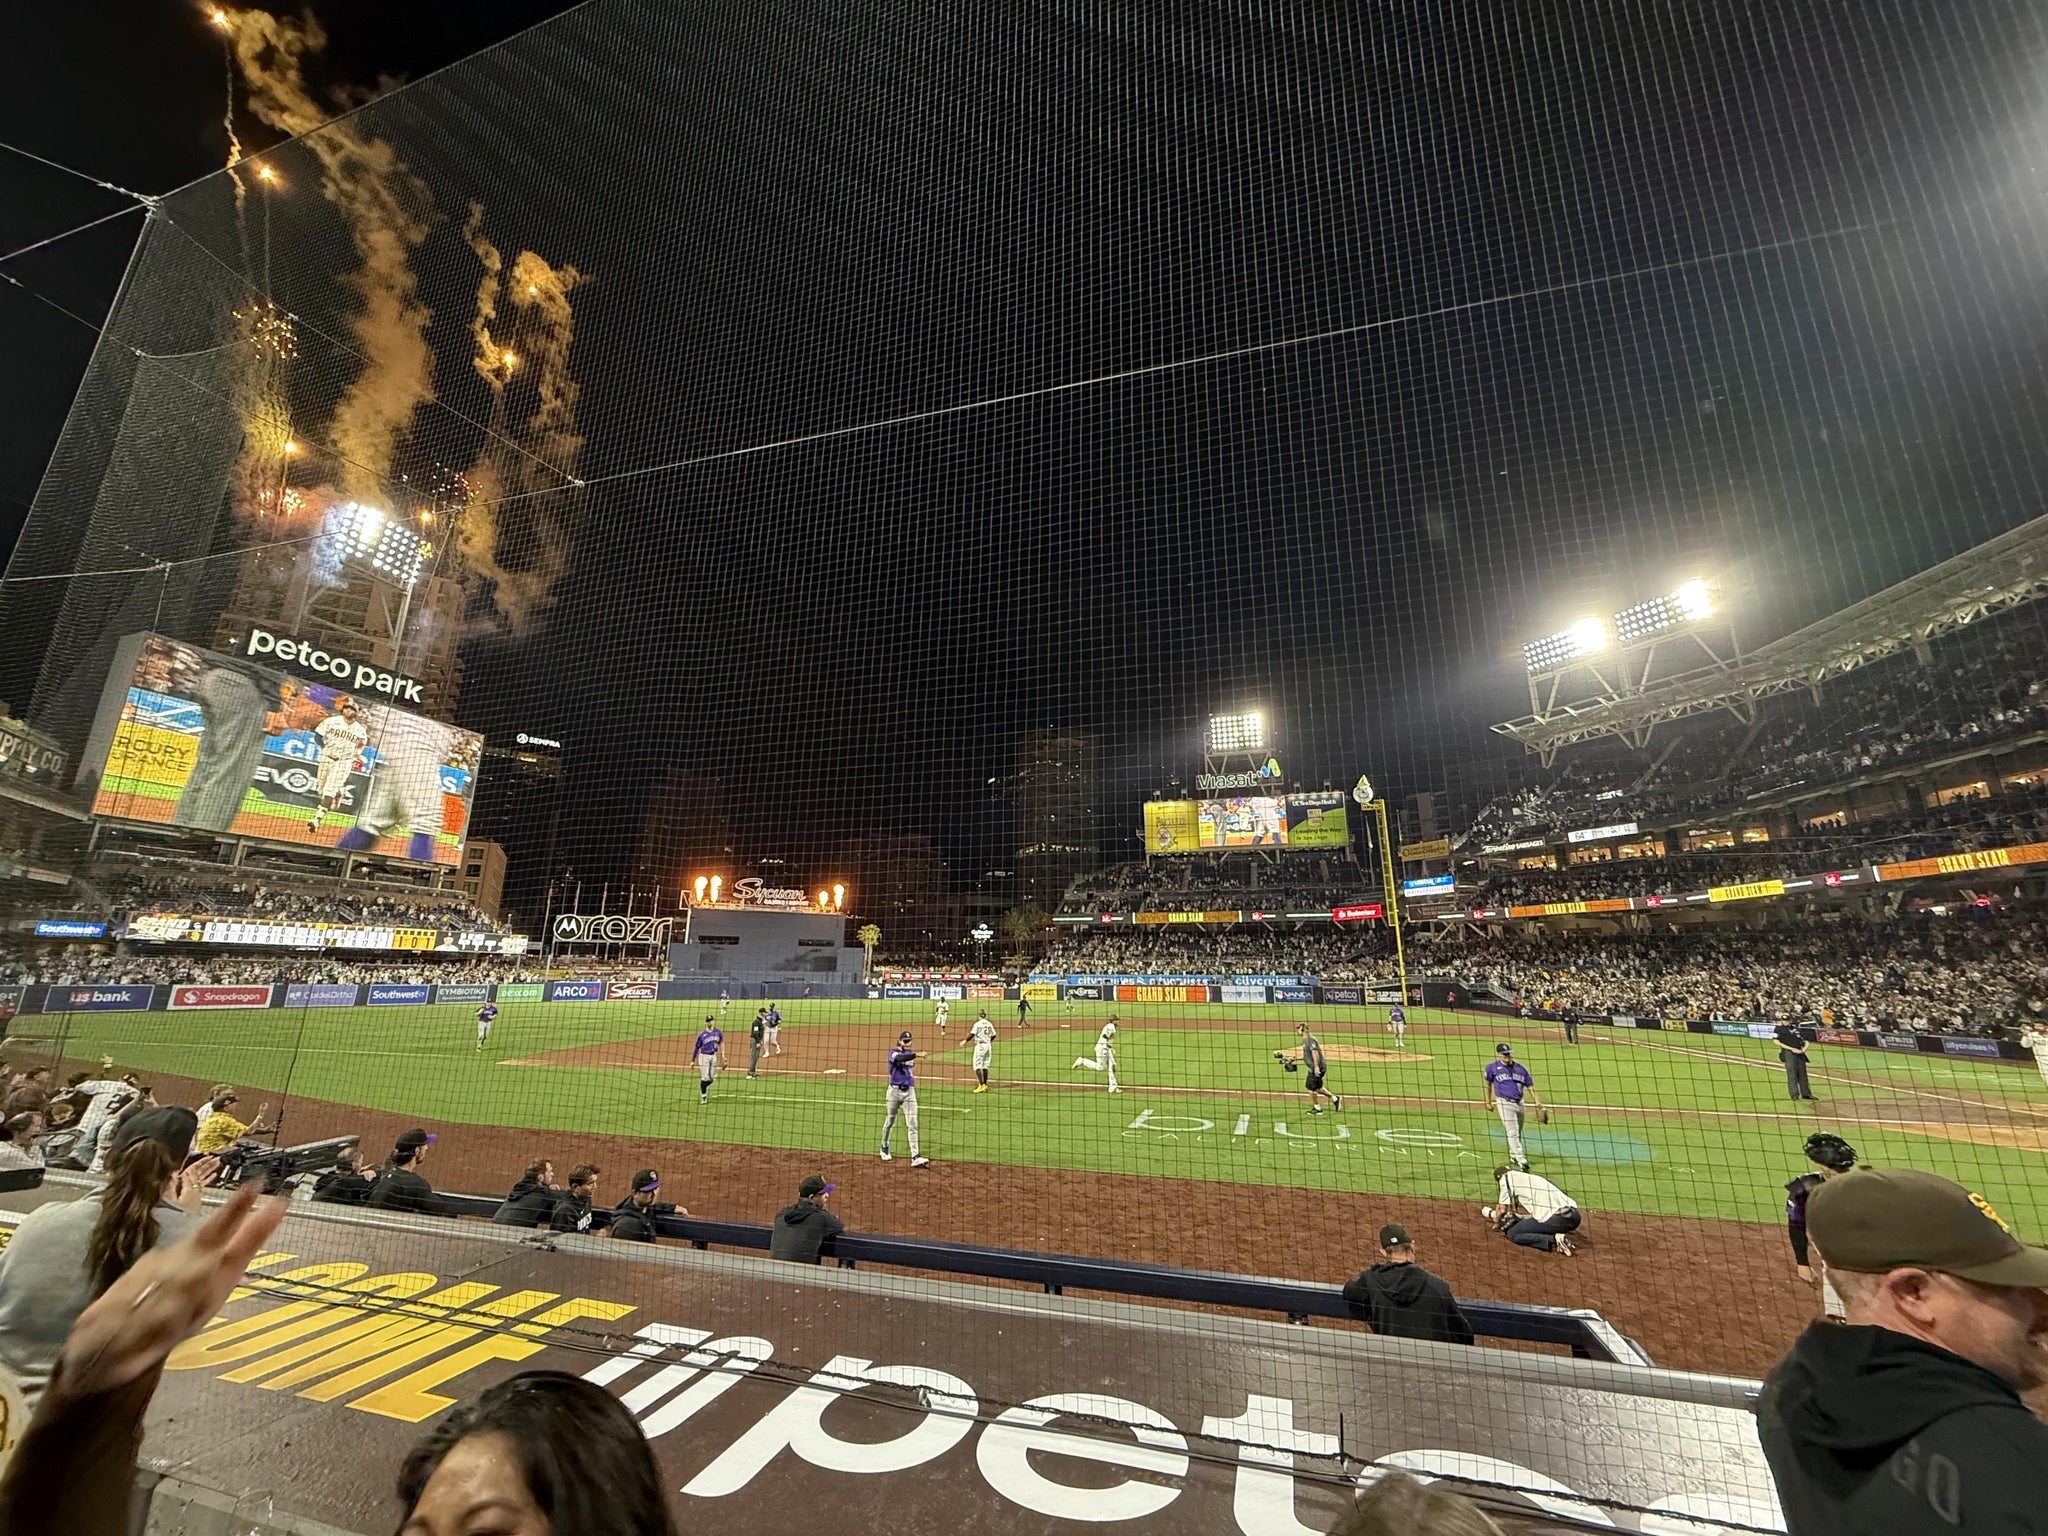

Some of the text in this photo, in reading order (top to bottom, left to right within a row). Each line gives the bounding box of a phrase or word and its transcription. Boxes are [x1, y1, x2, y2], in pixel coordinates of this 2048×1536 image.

[247, 629, 424, 703] petco park
[1199, 771, 1257, 790] Viasat
[1937, 849, 2010, 873] GRAND SLAM
[733, 878, 806, 904] Sycuan
[1169, 913, 1187, 922] GRAND
[39, 924, 93, 934] Southwest
[584, 915, 673, 943] razr
[92, 991, 131, 1002] bank
[204, 992, 260, 1002] Snapdragon
[372, 990, 420, 999] Southwest
[554, 986, 588, 997] ARCO
[1137, 987, 1187, 1002] GRAND SLAM
[1335, 990, 1357, 999] petco
[1128, 1109, 1464, 1149] blue
[1121, 1130, 1483, 1160] CALIFORNIA
